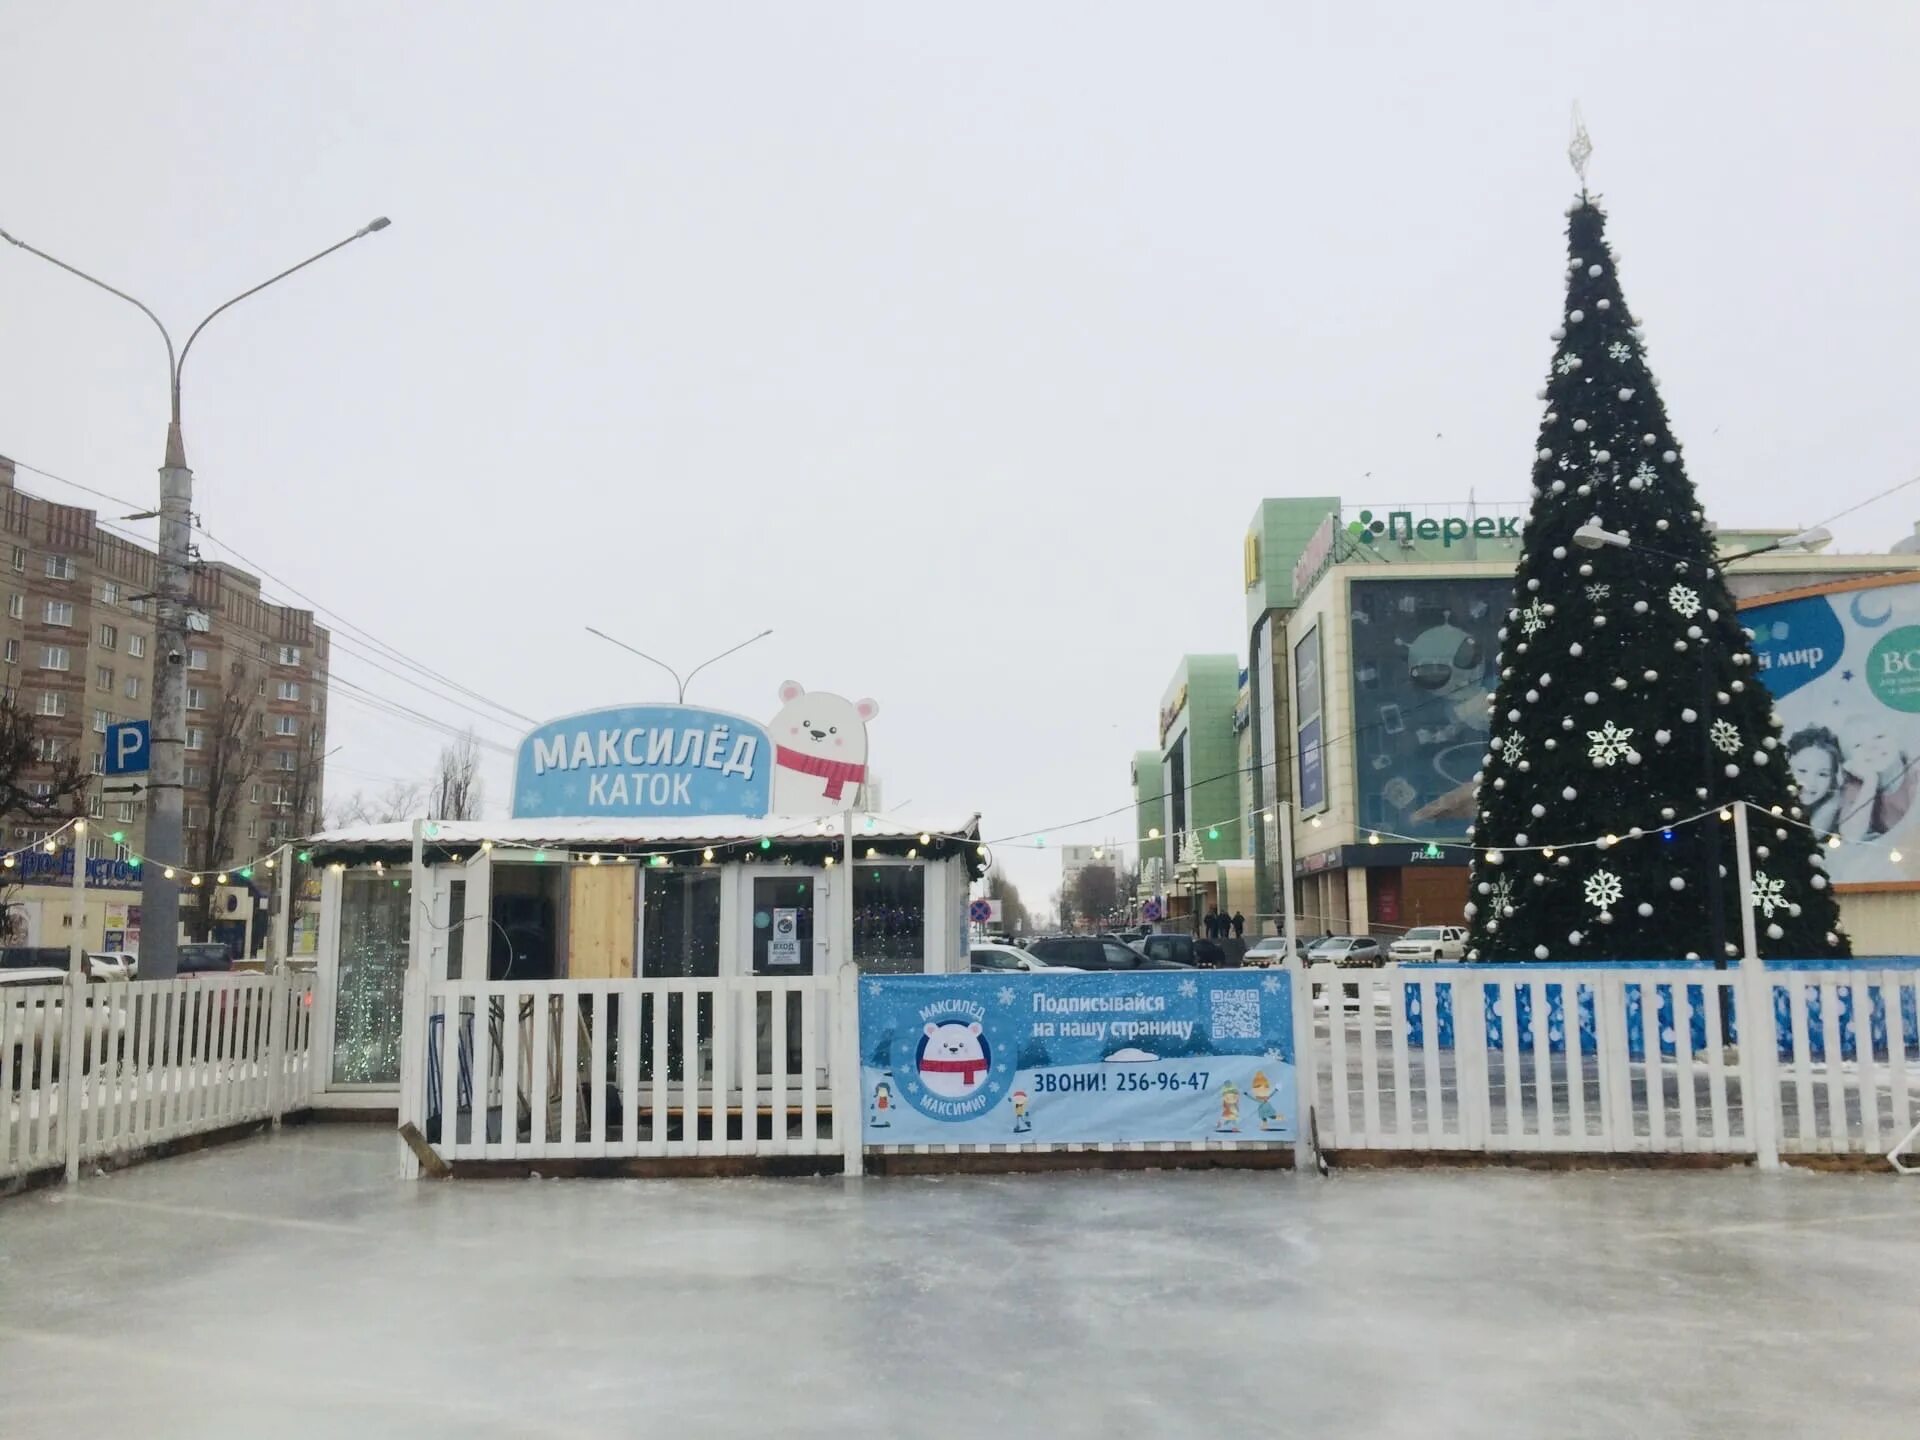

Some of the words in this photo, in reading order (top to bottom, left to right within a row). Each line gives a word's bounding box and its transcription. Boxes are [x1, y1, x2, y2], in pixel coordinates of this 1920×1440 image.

[1777, 647, 1824, 669] мир
[118, 727, 143, 769] P
[533, 724, 758, 781] МАКСИЛЁД
[588, 773, 693, 806] КАТОК
[1033, 992, 1165, 1014] Подписывайся
[1033, 1022, 1055, 1037] на
[1060, 1021, 1106, 1040] нашу
[1110, 1020, 1194, 1041] страницу
[1033, 1073, 1107, 1093] ЗВОНИ!
[1116, 1071, 1211, 1092] 256-96-47
[920, 1095, 987, 1116] МАКСИМИР
